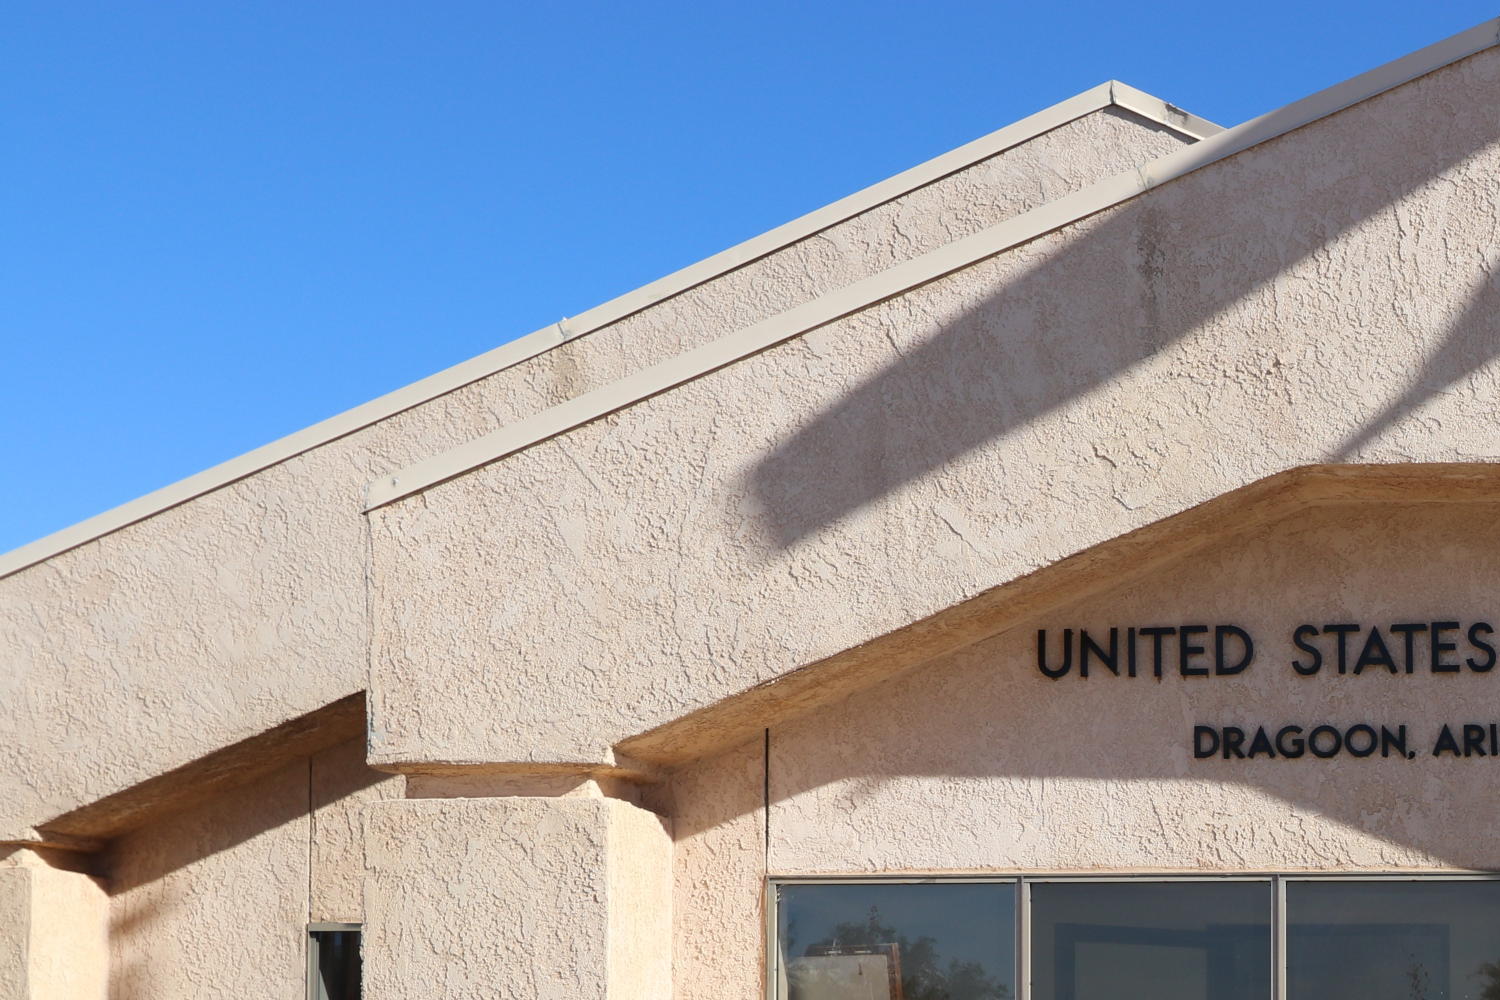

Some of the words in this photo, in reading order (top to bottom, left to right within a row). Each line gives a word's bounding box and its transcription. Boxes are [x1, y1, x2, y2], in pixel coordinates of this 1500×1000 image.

[1037, 625, 1254, 680] UNITED
[1291, 621, 1497, 676] STATES
[1193, 723, 1417, 760] DRAGOON,
